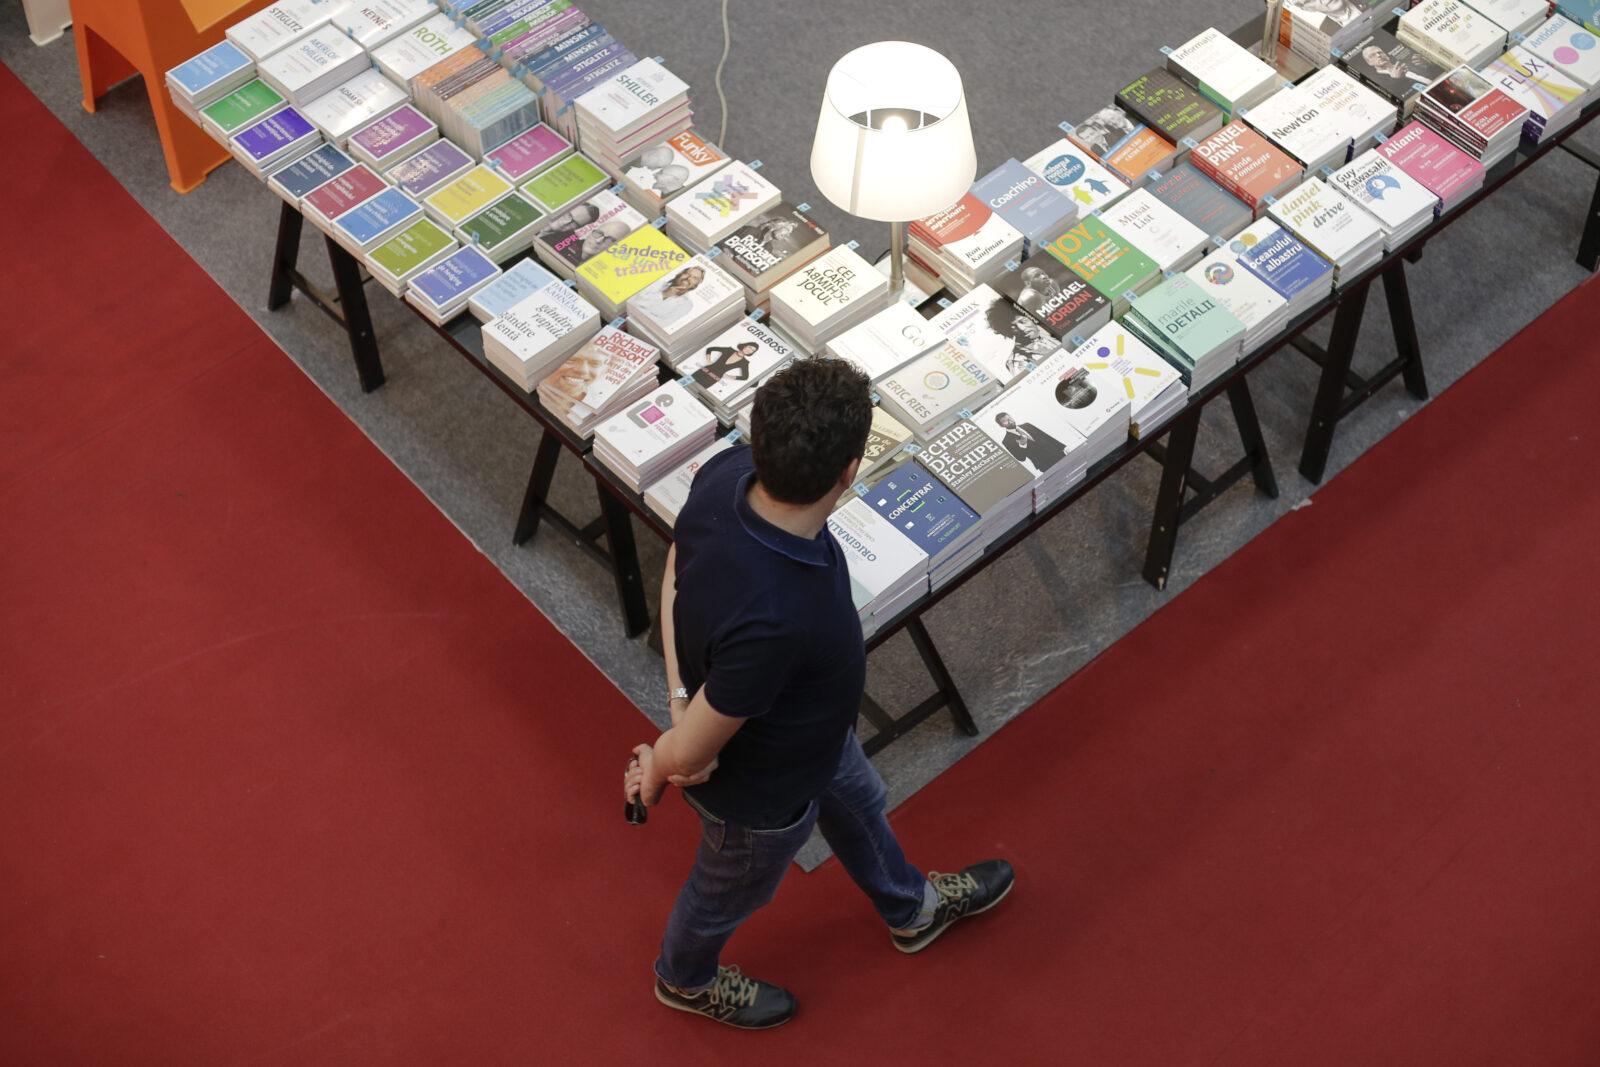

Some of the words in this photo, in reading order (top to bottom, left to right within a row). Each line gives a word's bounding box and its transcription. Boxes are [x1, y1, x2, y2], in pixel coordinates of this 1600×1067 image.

[269, 7, 303, 33] STIGLITZ
[360, 8, 392, 30] KEYNES
[1437, 14, 1460, 32] social
[1529, 18, 1567, 49] Antidotul
[300, 45, 328, 66] SHILLER
[413, 27, 453, 56] ROTH
[554, 29, 590, 53] MINSKY
[564, 40, 599, 63] MINSKY
[1175, 32, 1218, 61] Informația
[573, 48, 610, 73] STIGLITZ
[584, 59, 621, 82] STIGLITZ
[1500, 58, 1544, 91] FLUX
[616, 74, 659, 106] SHILLER
[1314, 79, 1341, 99] Liderii
[1271, 108, 1319, 139] Newton
[672, 133, 713, 164] Funky
[1197, 123, 1247, 157] DANIEL
[1208, 142, 1244, 166] PINK
[1384, 126, 1425, 160] Alianța
[1233, 156, 1252, 173] vinde
[1336, 167, 1357, 184] Guy
[1344, 158, 1388, 190] Kawasaki
[1281, 183, 1322, 216] daniel
[1292, 199, 1324, 227] pink
[555, 214, 599, 251] EXPRESUL
[597, 202, 628, 224] URBAN
[1118, 203, 1151, 226] Musai
[1133, 213, 1155, 230] List
[1312, 201, 1345, 229] drive
[605, 241, 686, 263] Gândește
[725, 236, 771, 271] Branson
[740, 235, 782, 265] Richard
[965, 246, 982, 259] Ron
[971, 238, 1004, 263] Kaufman
[1045, 222, 1106, 265] JOY,
[1250, 235, 1292, 269] oceanului
[1266, 243, 1303, 272] albastru
[822, 269, 850, 291] CARE
[836, 265, 857, 281] CEI
[544, 287, 589, 320] KAHNEMAN
[551, 282, 579, 302] DANIEL
[797, 279, 833, 307] JOCUL
[1036, 281, 1086, 317] MICHAEL
[536, 304, 574, 333] gândire
[938, 300, 980, 331] HENDRIX
[1045, 290, 1093, 326] JORDAN
[1157, 297, 1194, 326] marile
[1165, 300, 1216, 334] DETALII
[494, 320, 521, 342] lentă
[499, 312, 536, 338] gândire
[593, 335, 645, 365] Branson
[608, 331, 655, 357] Richard
[934, 352, 979, 387] STARTUP
[943, 344, 964, 362] THE
[961, 360, 989, 384] LEAN
[885, 379, 908, 401] ERIC
[906, 399, 932, 420] RIES
[918, 421, 977, 463] ECHIPA
[929, 453, 956, 473] DE
[940, 439, 999, 483] ECHIPE
[951, 470, 972, 488] Stanley
[888, 482, 935, 521] CONCENTRAT
